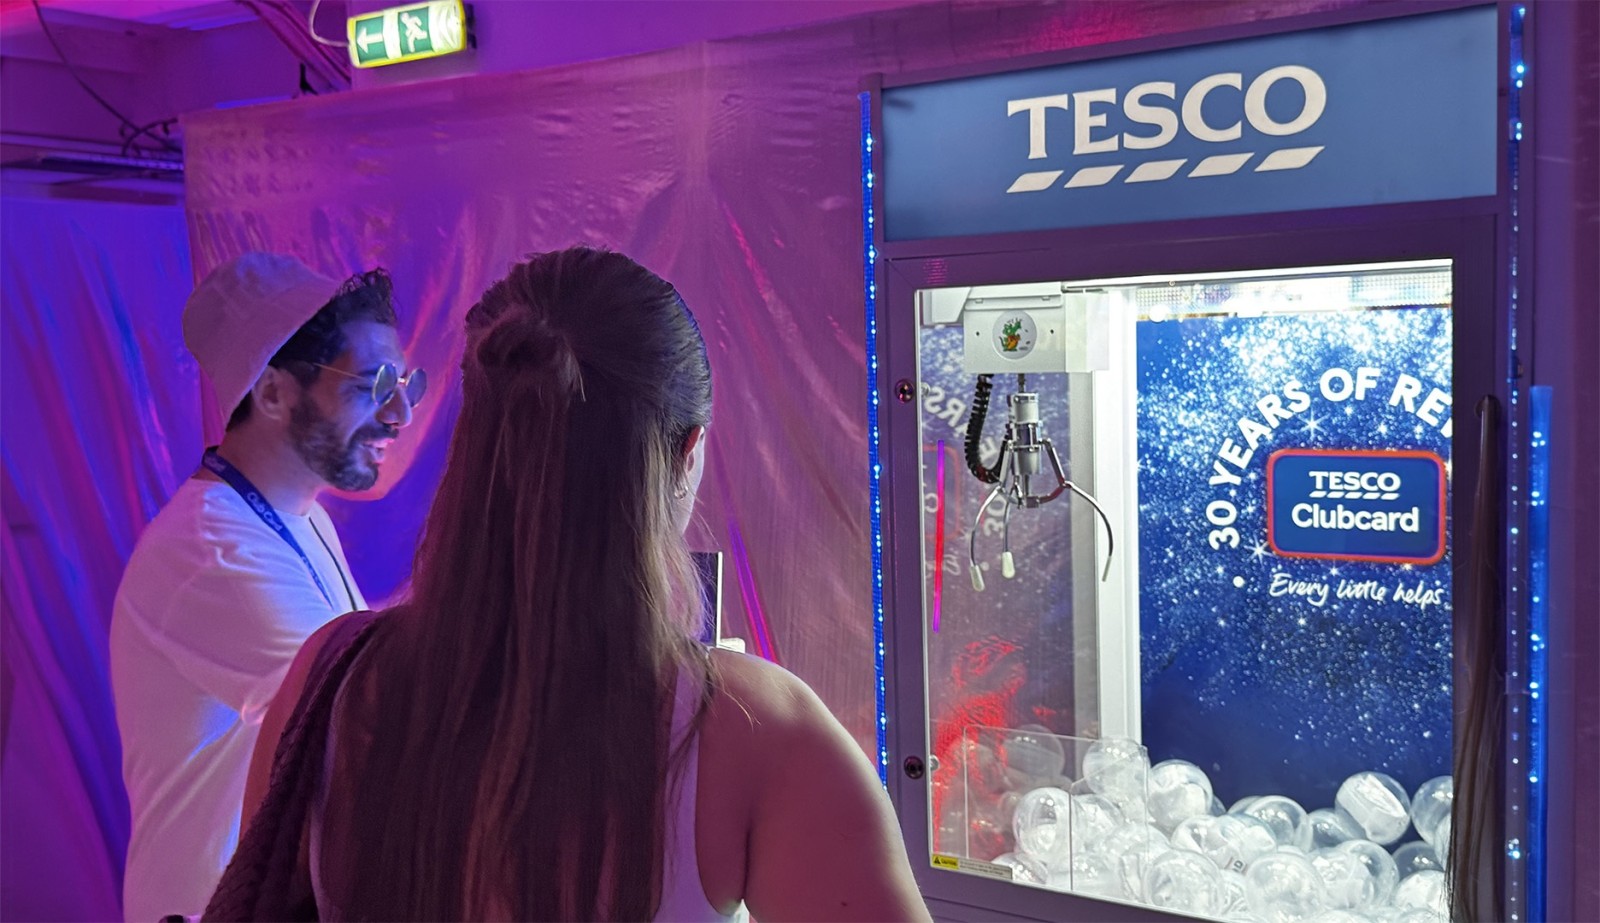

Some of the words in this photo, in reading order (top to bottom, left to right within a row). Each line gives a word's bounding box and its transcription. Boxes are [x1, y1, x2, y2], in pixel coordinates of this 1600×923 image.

[1007, 65, 1326, 159] TESCO
[1320, 366, 1381, 402] OF
[1389, 373, 1452, 438] RE
[1208, 380, 1311, 486] YEARS
[1308, 471, 1401, 491] TESCO
[1206, 500, 1241, 550] 30
[1291, 503, 1419, 532] Clubcard
[1269, 573, 1329, 607] Every
[1336, 579, 1386, 600] little
[1393, 580, 1445, 609] helps
